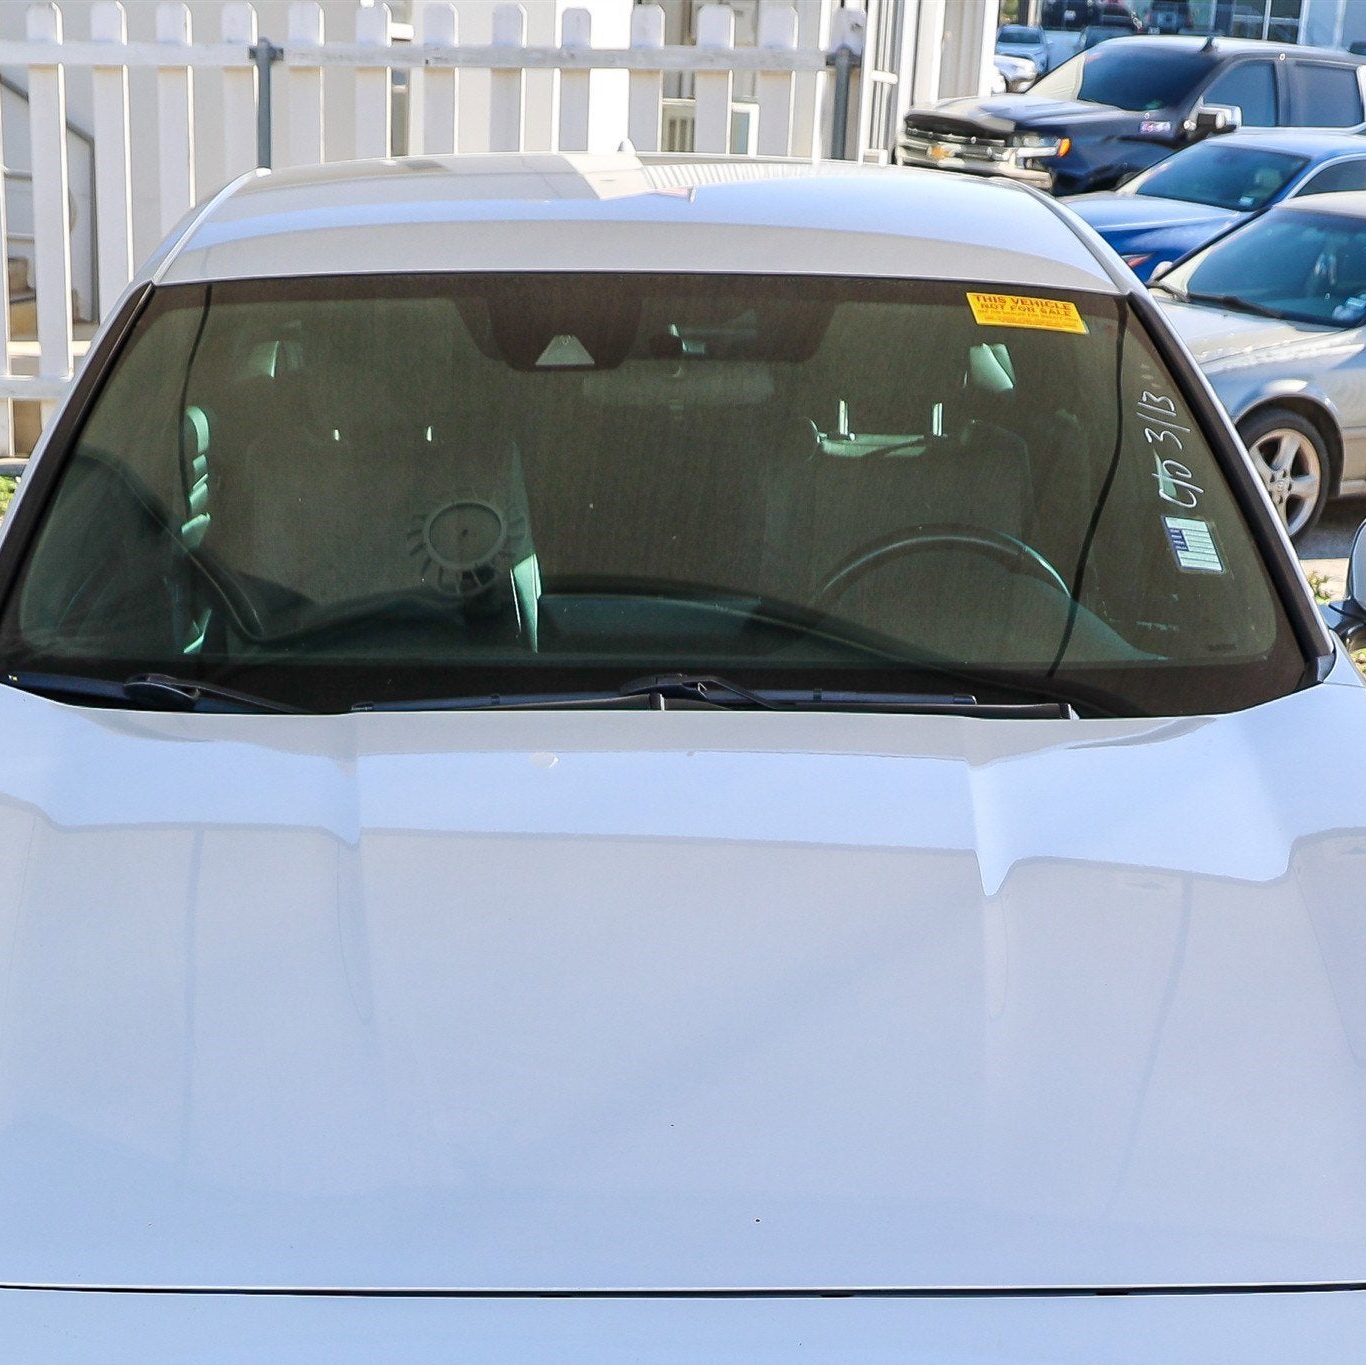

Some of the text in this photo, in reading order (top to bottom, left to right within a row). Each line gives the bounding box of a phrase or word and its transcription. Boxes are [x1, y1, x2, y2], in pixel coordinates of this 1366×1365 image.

[975, 295, 1072, 311] THIS VEHICLE
[981, 303, 1072, 317] NOT FOR SALE
